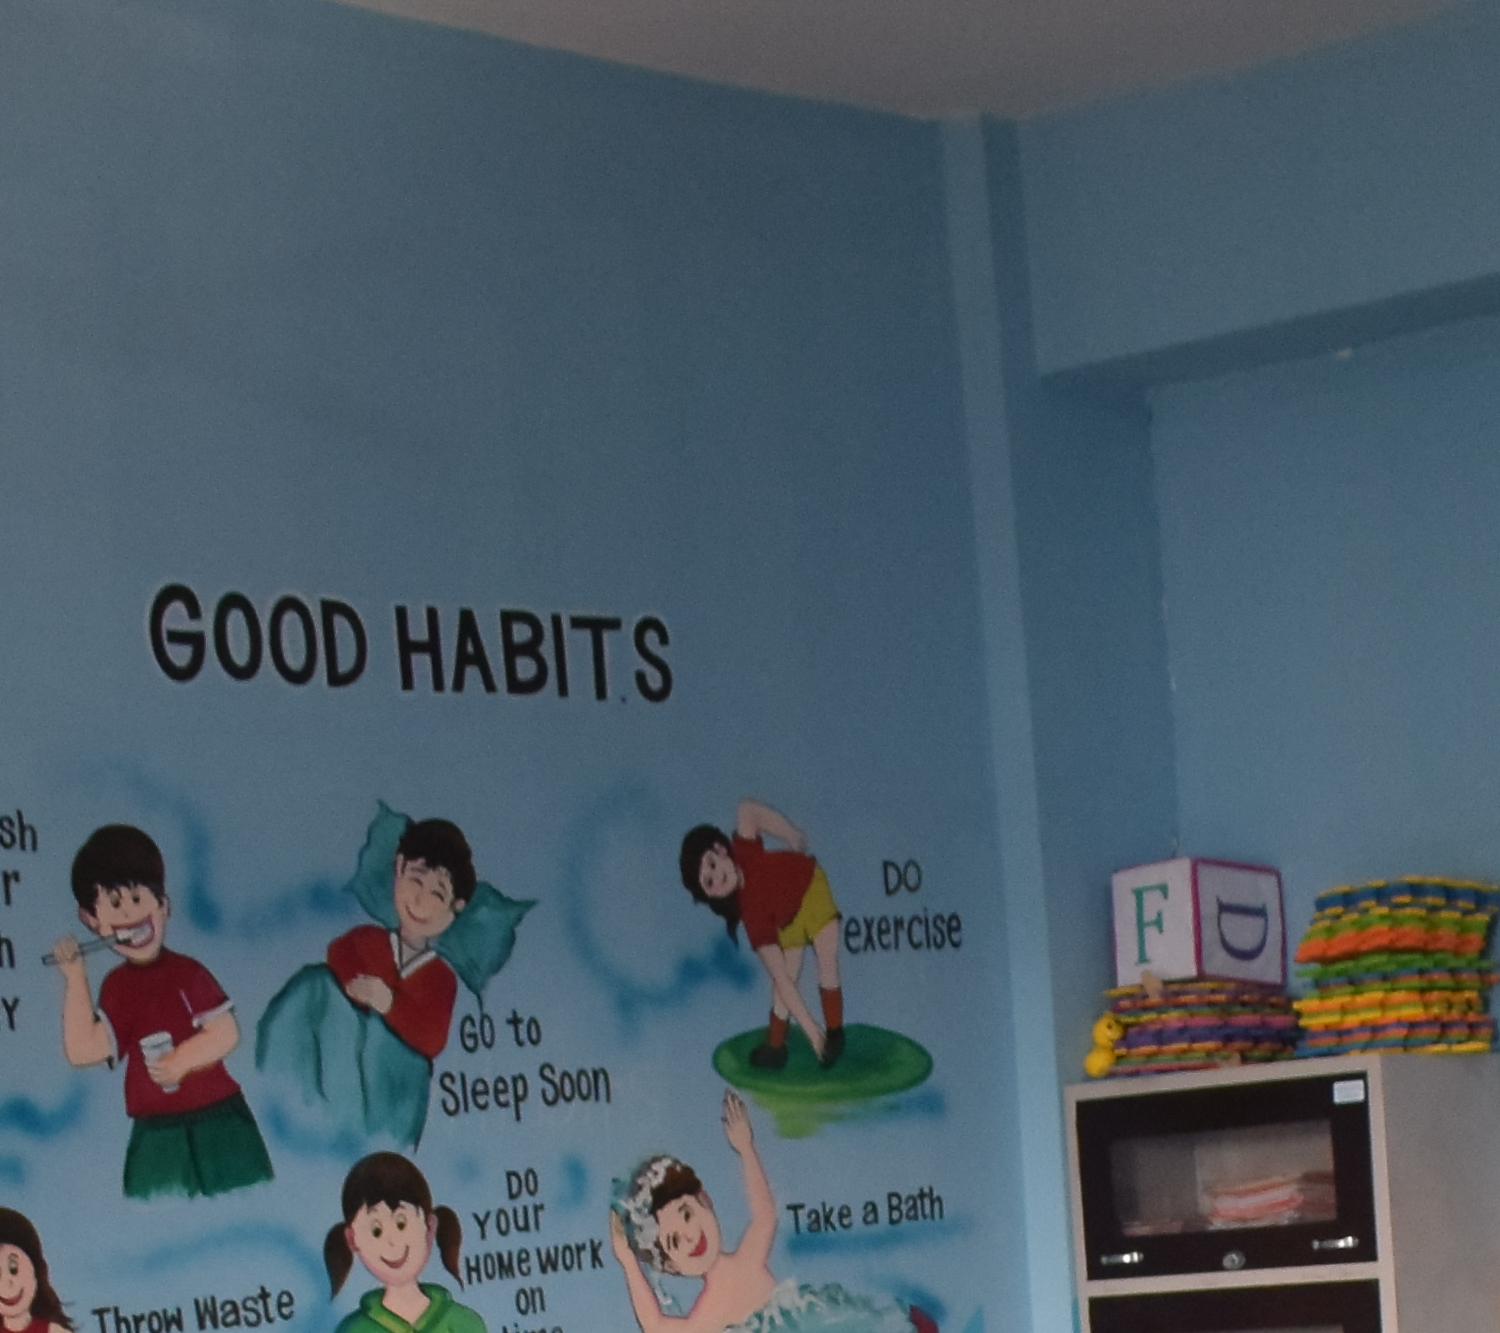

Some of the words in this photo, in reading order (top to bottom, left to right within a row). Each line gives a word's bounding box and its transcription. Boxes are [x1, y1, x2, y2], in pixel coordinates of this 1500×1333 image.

[149, 583, 367, 688] GOOD
[395, 606, 672, 703] HABITS
[844, 906, 963, 954] exercise
[1131, 883, 1168, 966] F
[1216, 896, 1268, 961] D
[506, 1009, 542, 1047] to
[439, 1071, 529, 1122] Sleep
[539, 1062, 612, 1106] Soon
[786, 1201, 854, 1234] Take
[862, 1200, 879, 1225] a
[887, 1185, 945, 1225] Bath
[194, 1285, 295, 1331] Waste
[515, 1286, 546, 1316] on
